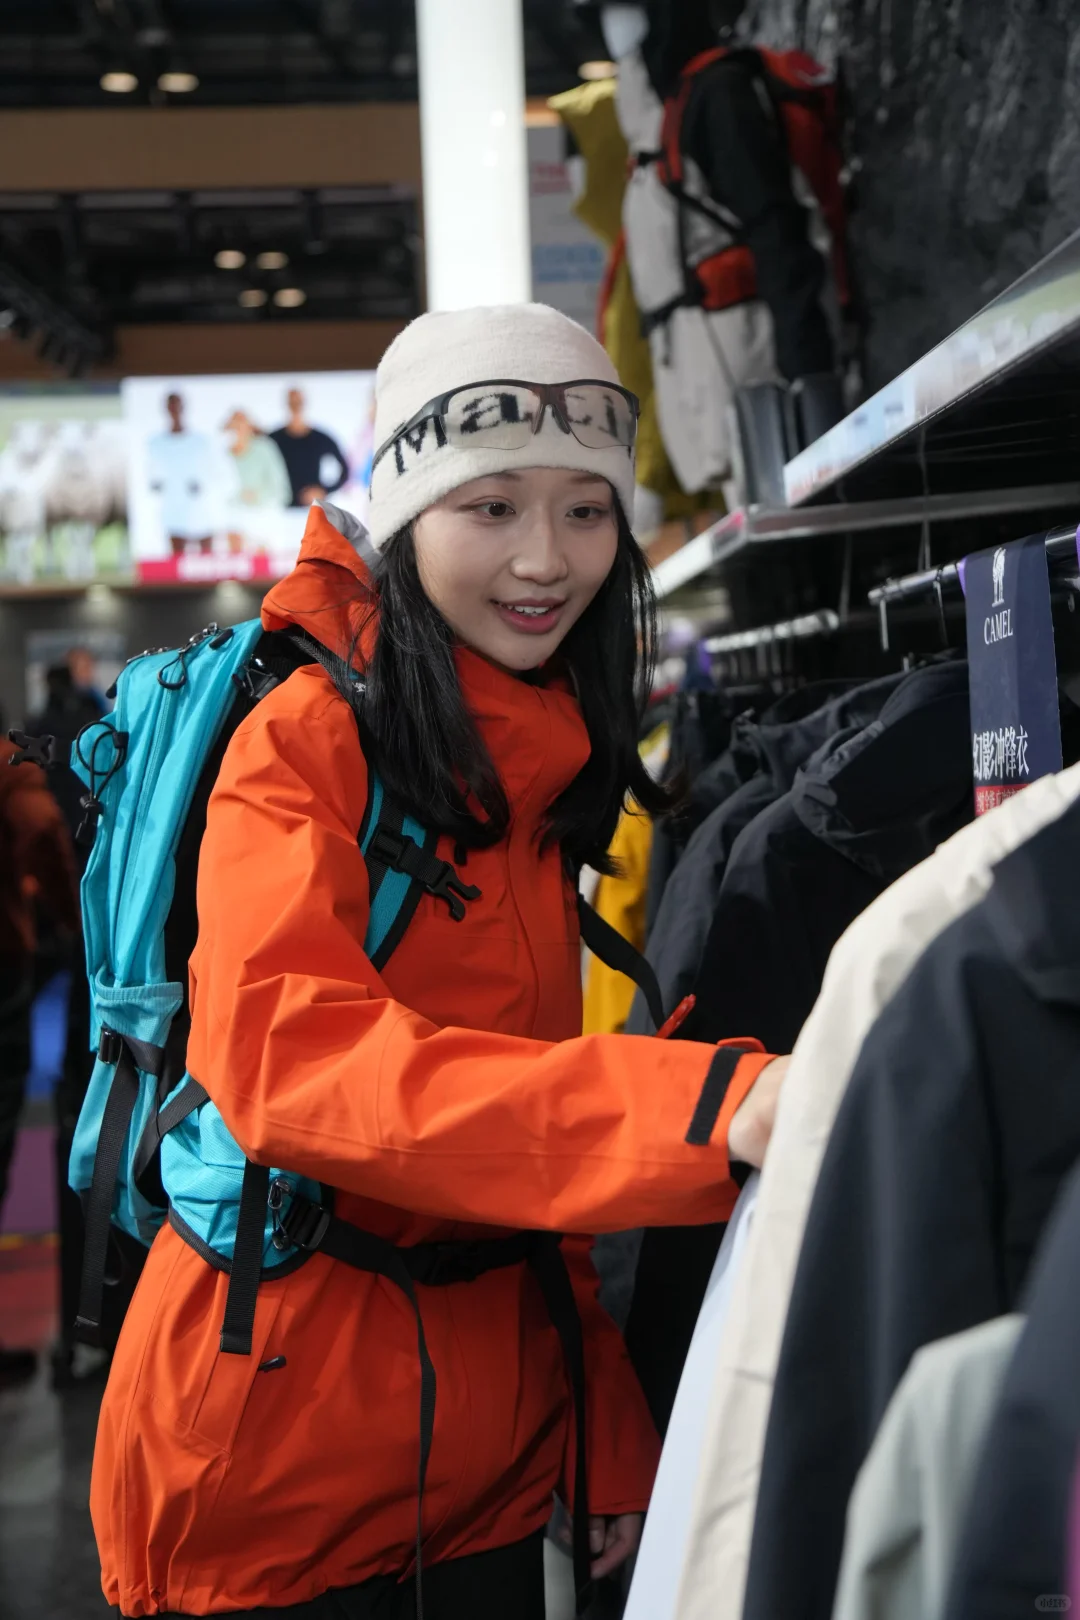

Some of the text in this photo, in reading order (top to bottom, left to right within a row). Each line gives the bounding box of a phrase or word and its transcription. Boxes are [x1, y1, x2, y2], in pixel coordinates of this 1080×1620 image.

[984, 609, 1013, 645] CAMEL
[972, 724, 1030, 781] 幻影冲锋衣
